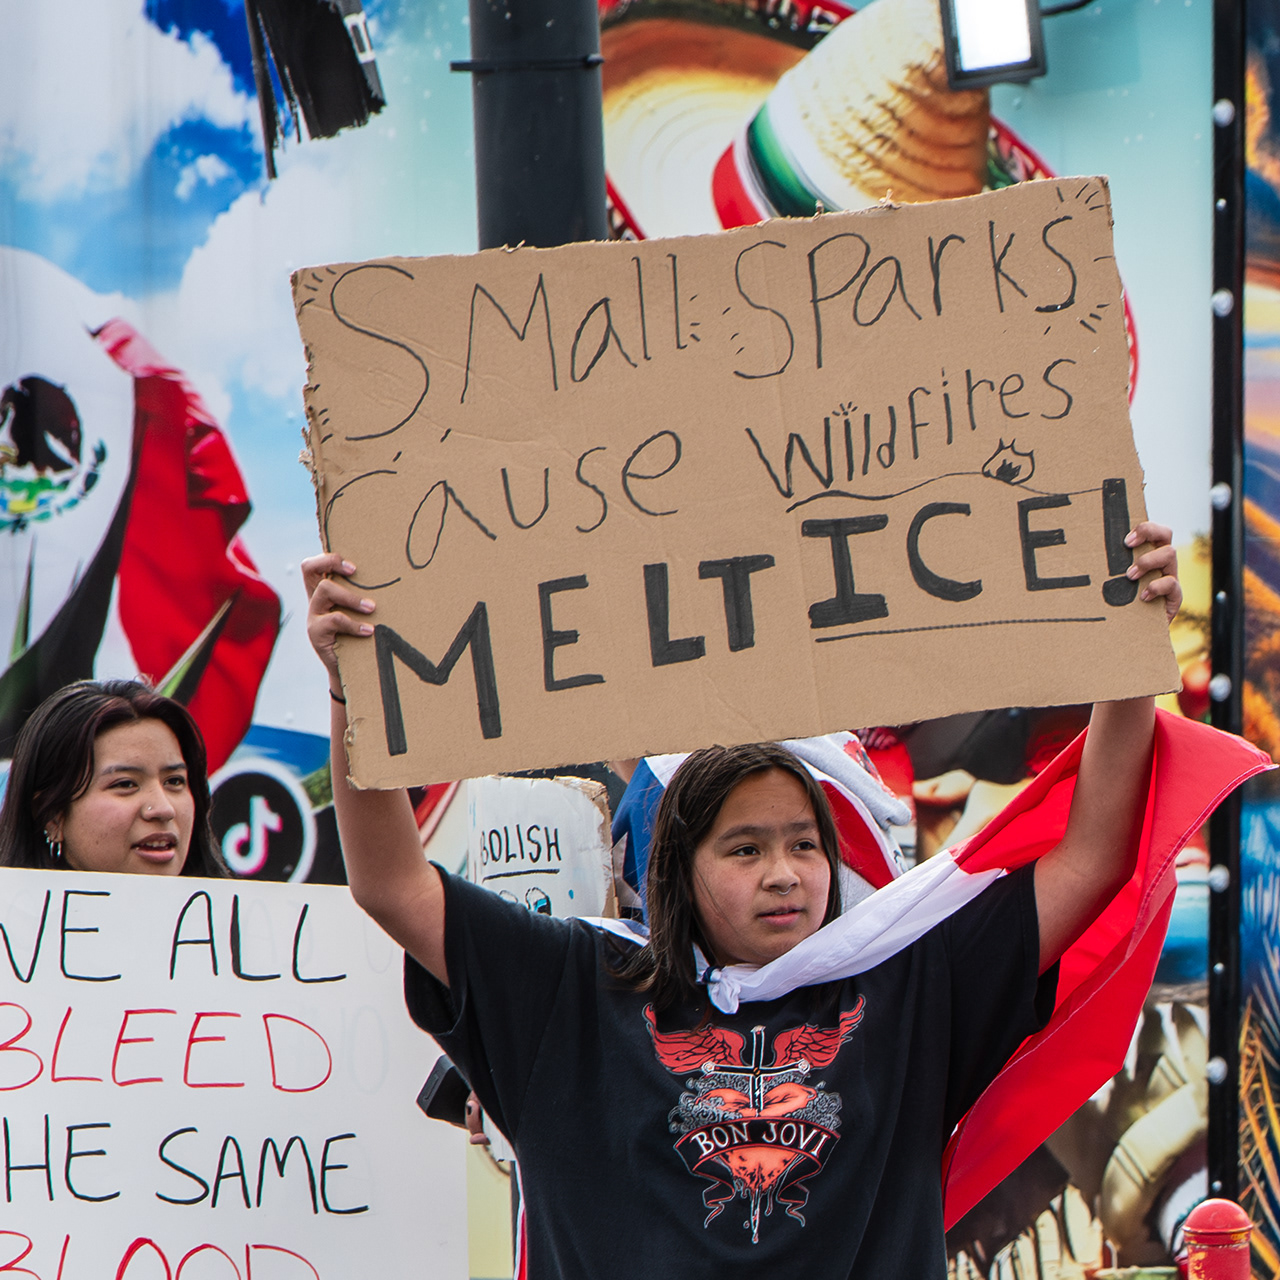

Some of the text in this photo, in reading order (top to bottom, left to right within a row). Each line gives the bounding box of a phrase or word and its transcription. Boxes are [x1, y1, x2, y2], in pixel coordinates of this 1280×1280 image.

[374, 477, 1139, 757] MELT ICE!
[480, 823, 562, 866] BOLISH
[169, 888, 348, 984] ALL
[0, 1001, 333, 1093] BLEED
[2, 1113, 370, 1216] HE SAME
[690, 1120, 831, 1157] BON JOVI
